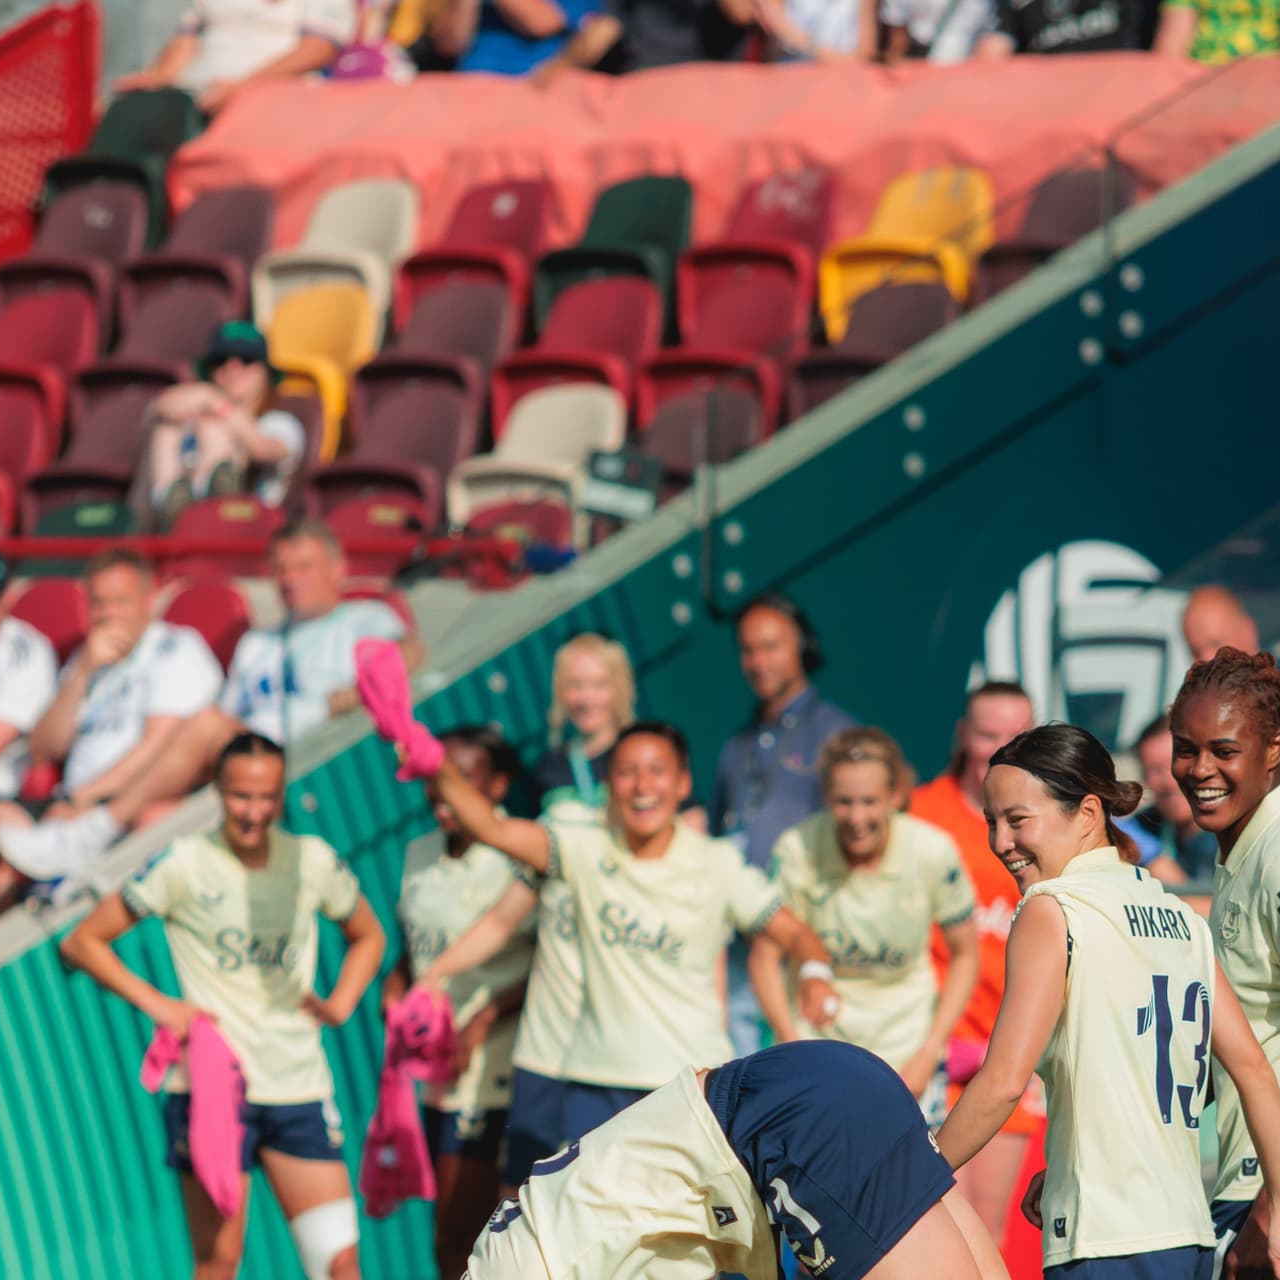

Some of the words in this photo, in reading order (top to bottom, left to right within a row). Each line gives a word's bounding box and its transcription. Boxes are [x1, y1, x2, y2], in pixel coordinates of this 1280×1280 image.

[599, 901, 683, 960] Stake
[1123, 904, 1191, 941] HIKARU
[1136, 974, 1210, 1129] 13
